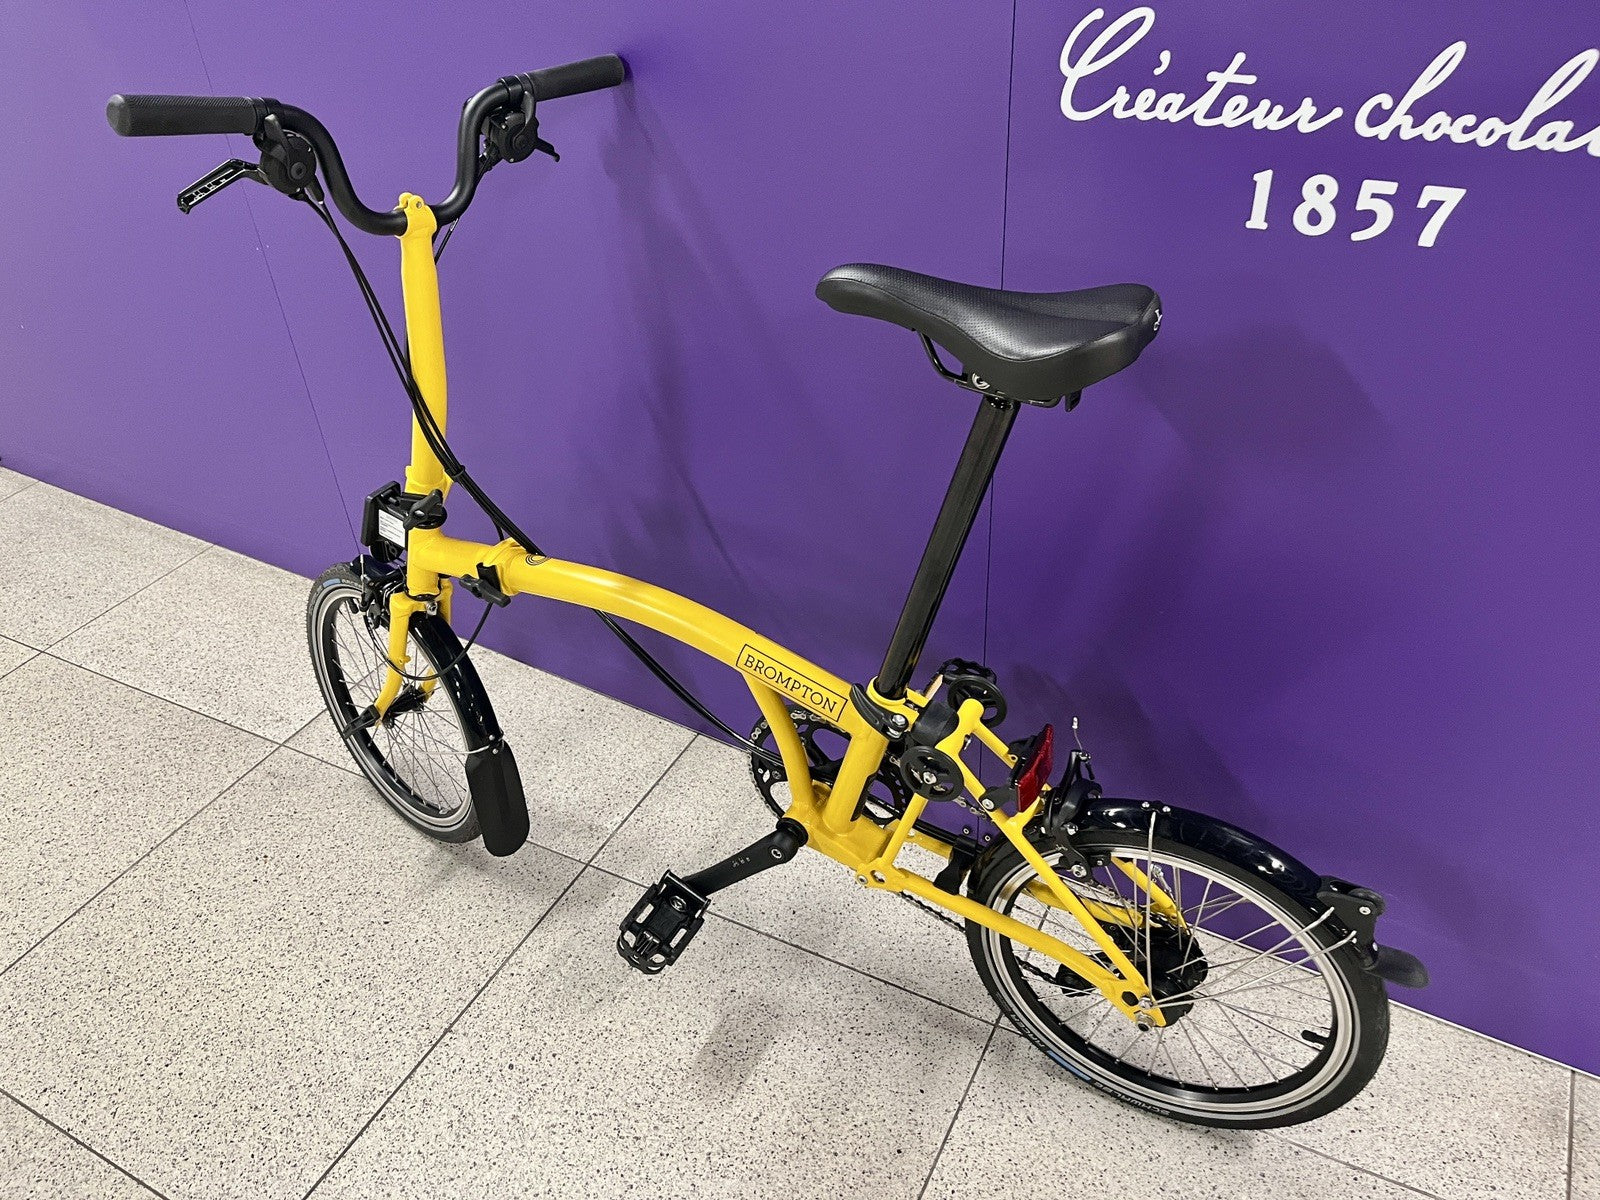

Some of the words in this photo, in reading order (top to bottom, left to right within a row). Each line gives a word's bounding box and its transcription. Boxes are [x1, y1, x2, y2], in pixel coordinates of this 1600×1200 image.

[1060, 7, 1343, 133] Créateur
[1246, 169, 1467, 247] 1857
[743, 654, 838, 713] BROMPTON
